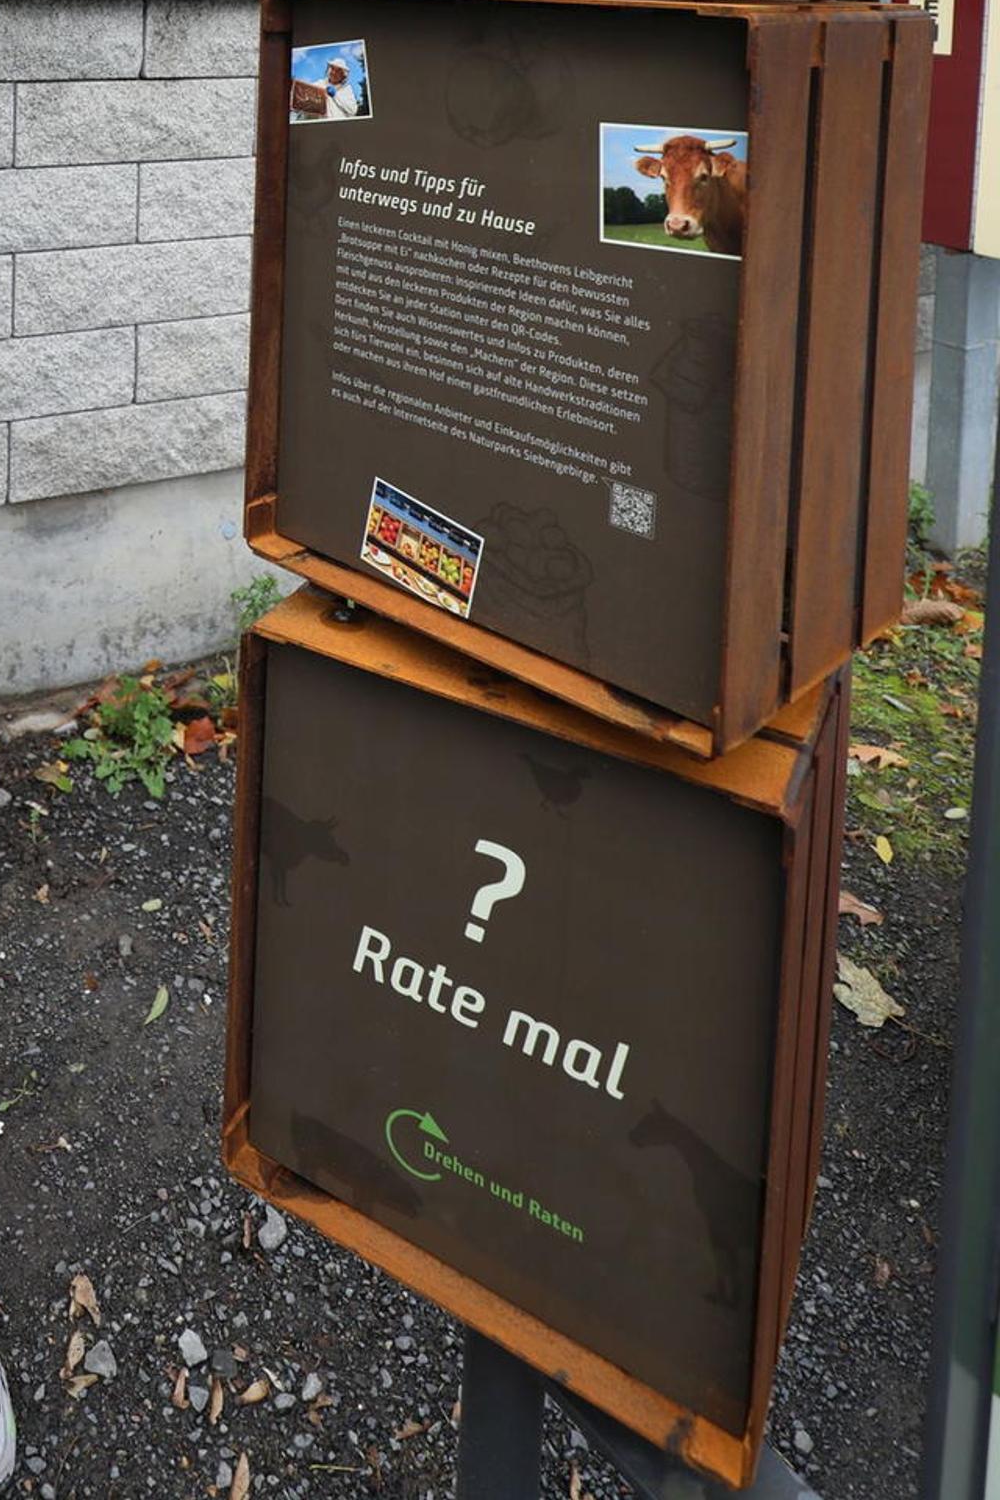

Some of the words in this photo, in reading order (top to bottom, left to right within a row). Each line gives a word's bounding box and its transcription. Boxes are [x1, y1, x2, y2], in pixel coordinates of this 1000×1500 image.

[340, 157, 376, 180] Infos
[380, 166, 409, 184] und
[414, 170, 455, 195] Tipps
[459, 177, 485, 199] für
[339, 186, 417, 215] unterwegs
[422, 201, 453, 219] und
[456, 209, 476, 224] zu
[480, 209, 535, 235] Hause
[450, 239, 478, 259] Honig
[478, 245, 510, 264] mixen,
[511, 252, 572, 276] Beethovens
[572, 265, 633, 293] Leibgericht
[466, 260, 489, 275] oder
[490, 265, 531, 288] Rezepte
[532, 274, 547, 288] für
[548, 278, 569, 293] den
[570, 282, 629, 307] bewussten
[428, 301, 462, 320] Station
[463, 309, 489, 327] unter
[490, 316, 509, 332] den
[510, 321, 561, 345] QR-Codes.
[439, 287, 488, 309] Produkten
[489, 299, 506, 314] der
[507, 303, 542, 326] Region
[543, 312, 585, 333] machen
[585, 322, 629, 346] können,
[454, 274, 517, 302] Inspirierende
[518, 288, 547, 306] Ideen
[547, 295, 578, 315] dafür,
[579, 305, 602, 319] was
[603, 308, 621, 324] Sie
[622, 312, 651, 331] alles
[417, 314, 485, 343] Wissenswertes
[486, 332, 505, 348] und
[506, 338, 531, 355] Infos
[533, 347, 546, 359] zu
[547, 348, 604, 377] Produkten,
[606, 364, 639, 385] deren
[449, 339, 468, 355] den
[519, 359, 536, 375] der
[537, 364, 576, 389] Region.
[578, 375, 608, 395] Diese
[610, 384, 648, 406] setzen
[422, 348, 464, 371] besinnen
[465, 361, 484, 377] sich
[485, 367, 502, 382] auf
[502, 372, 522, 388] alte
[524, 378, 641, 423] Handwerkstraditionen
[445, 372, 472, 391] einen
[472, 380, 554, 419] gastfreundlichen
[555, 405, 617, 435] Erlebnisort.
[433, 402, 472, 425] Anbieter
[473, 415, 493, 432] und
[493, 421, 608, 473] Einkaufsmöglichkeiten
[608, 458, 632, 481] gibt
[449, 424, 467, 441] des
[468, 430, 521, 463] Naturparks
[522, 449, 598, 489] Siebengebirge.
[464, 839, 527, 943] ?
[352, 925, 486, 1028] Rate
[502, 1010, 630, 1100] mal
[424, 1140, 485, 1187] Drehen
[490, 1180, 524, 1208] und
[529, 1199, 584, 1242] Raten
